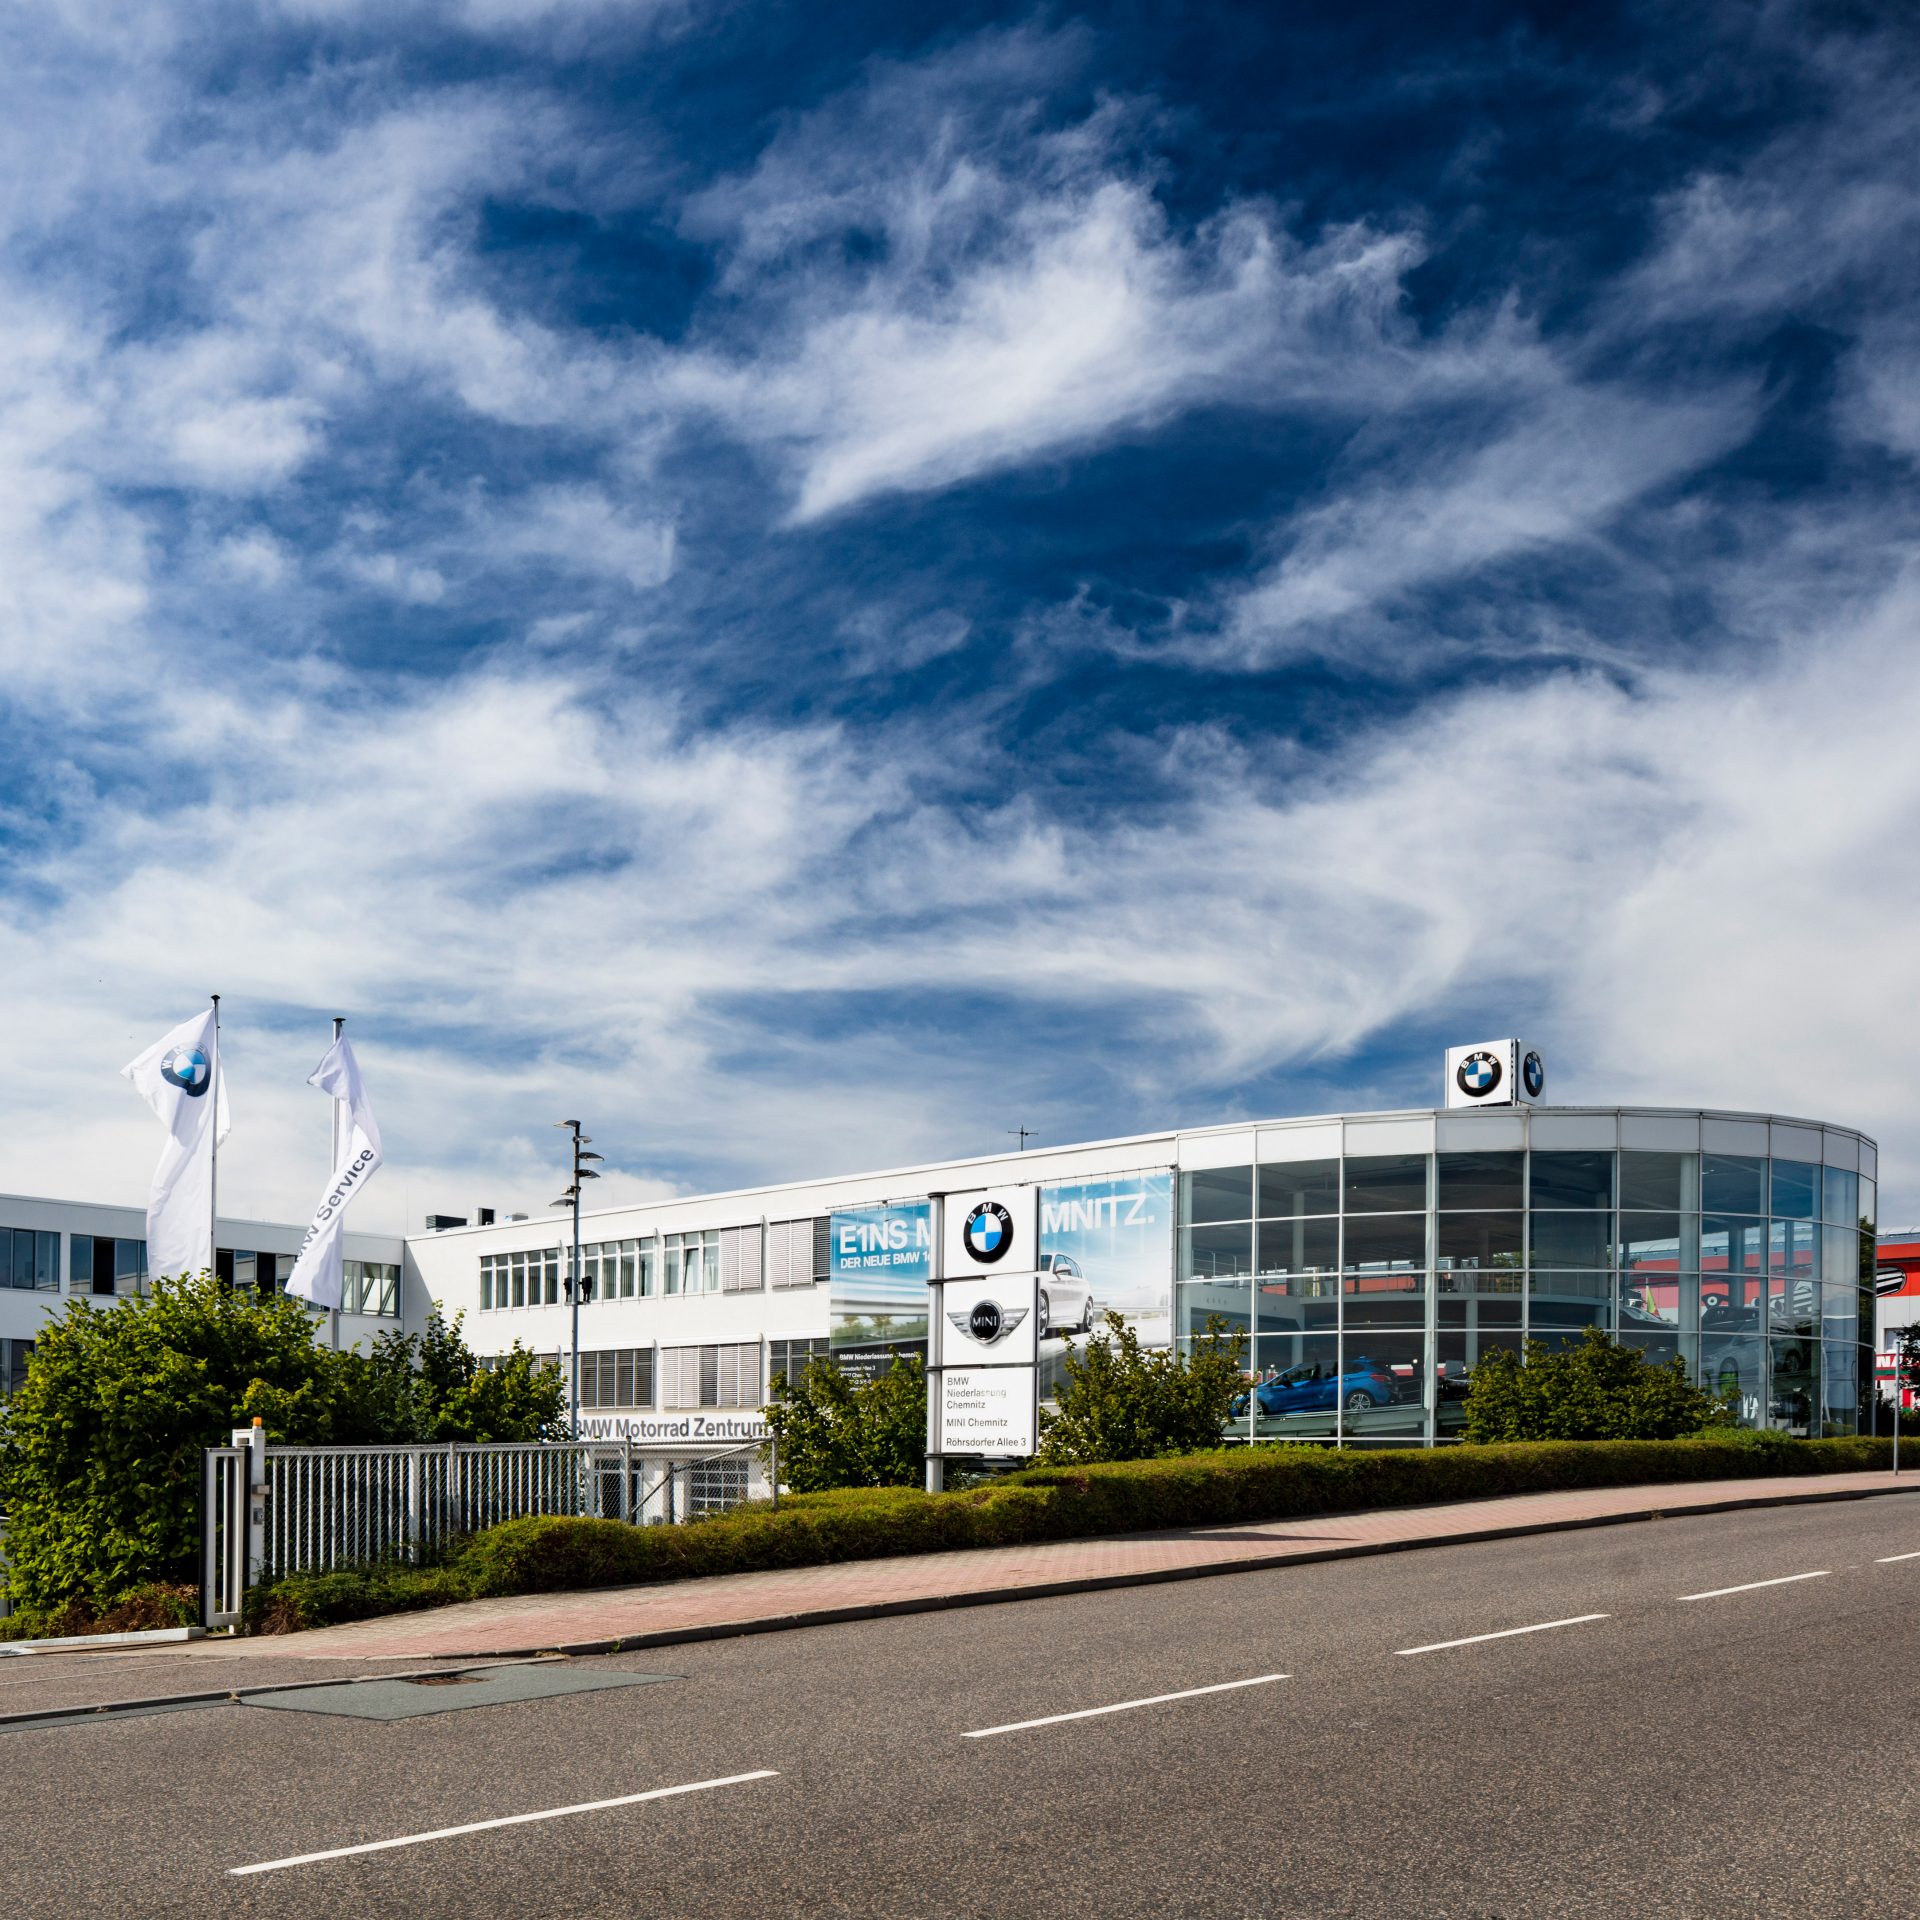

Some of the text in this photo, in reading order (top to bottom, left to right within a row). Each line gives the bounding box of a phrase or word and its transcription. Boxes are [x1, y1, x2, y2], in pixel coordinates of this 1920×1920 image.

[1460, 1052, 1498, 1069] BMW
[316, 1149, 374, 1221] Service
[967, 1202, 1009, 1225] BMW
[840, 1219, 908, 1254] E1NS
[840, 1257, 862, 1270] DER
[863, 1254, 892, 1267] NEUE
[893, 1251, 920, 1265] BMW
[972, 1315, 998, 1328] MINI
[947, 1377, 970, 1386] BMW
[946, 1400, 986, 1409] Chemnitz
[615, 1417, 690, 1438] Motorrad
[946, 1418, 1008, 1427] MINI Chemnitz
[946, 1437, 1027, 1447] Röhrsdorfer Allee 3
